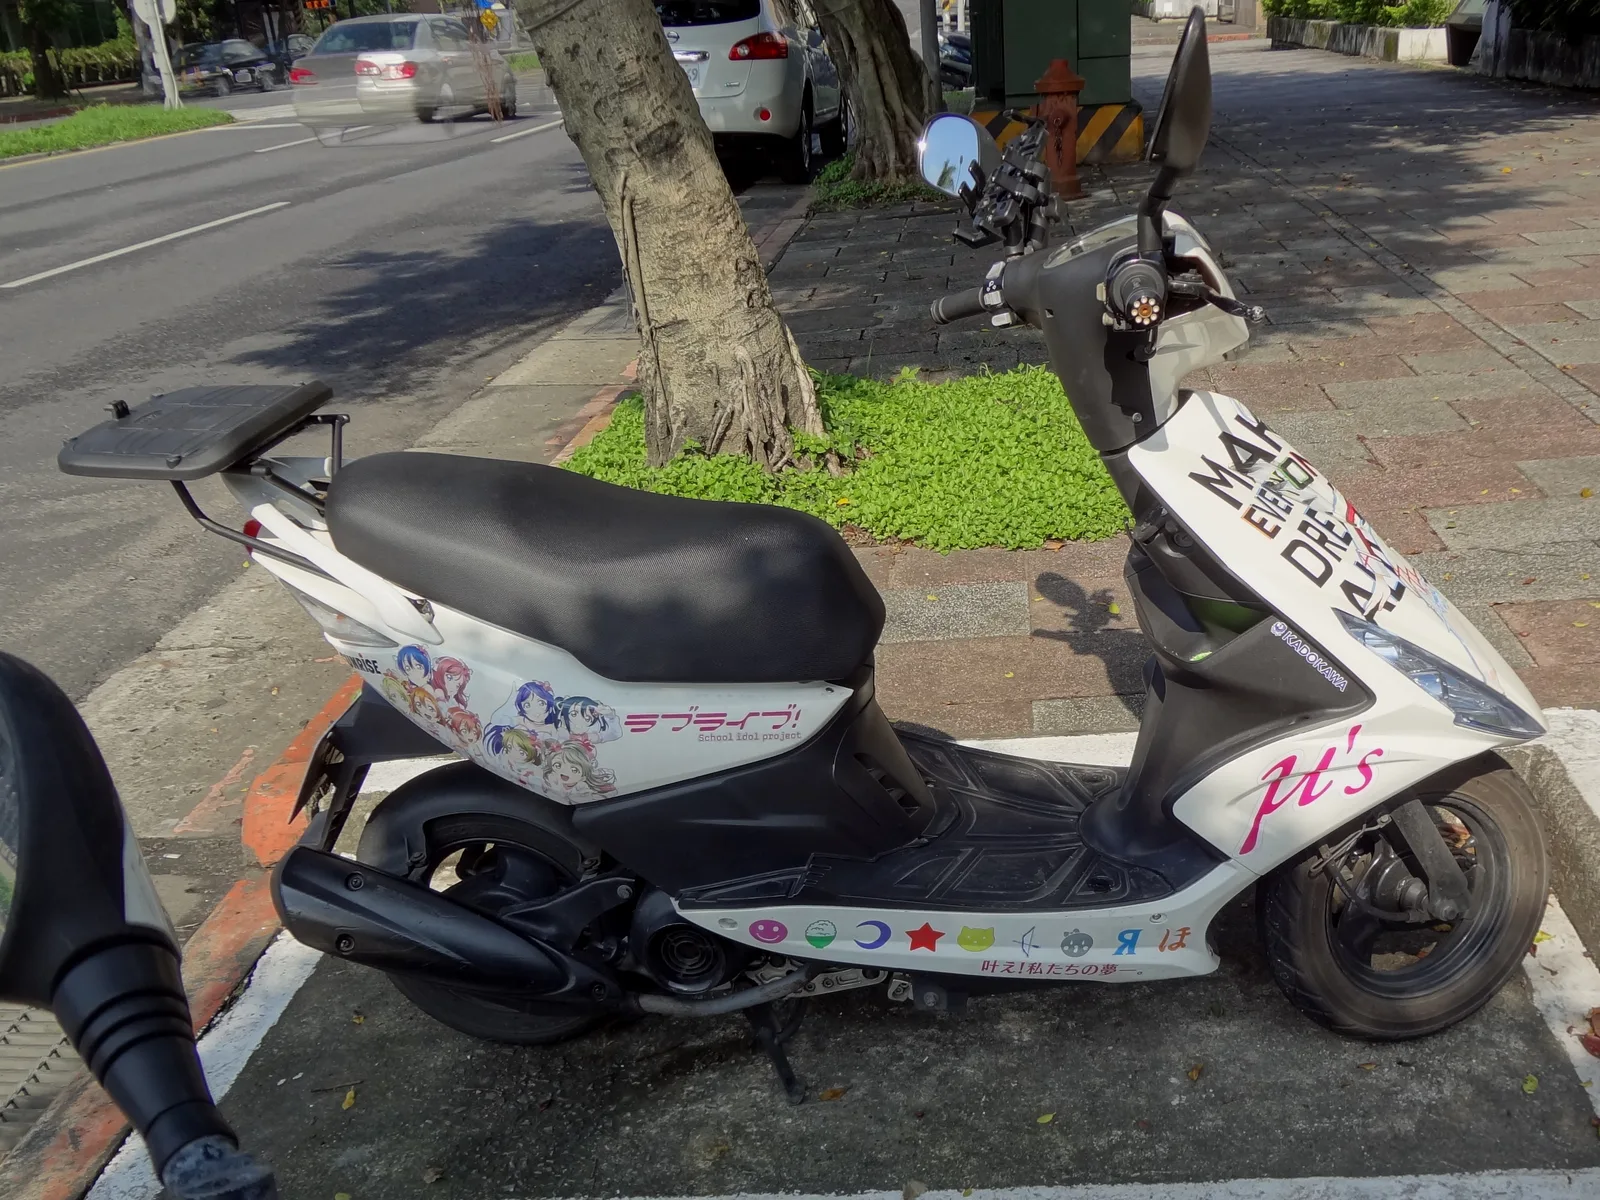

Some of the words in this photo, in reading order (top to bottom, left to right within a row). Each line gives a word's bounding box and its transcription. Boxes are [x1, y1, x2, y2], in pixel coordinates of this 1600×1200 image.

[1282, 630, 1348, 693] KADOKAWA
[698, 732, 734, 743] School
[736, 732, 760, 742] idol
[762, 731, 802, 742] project
